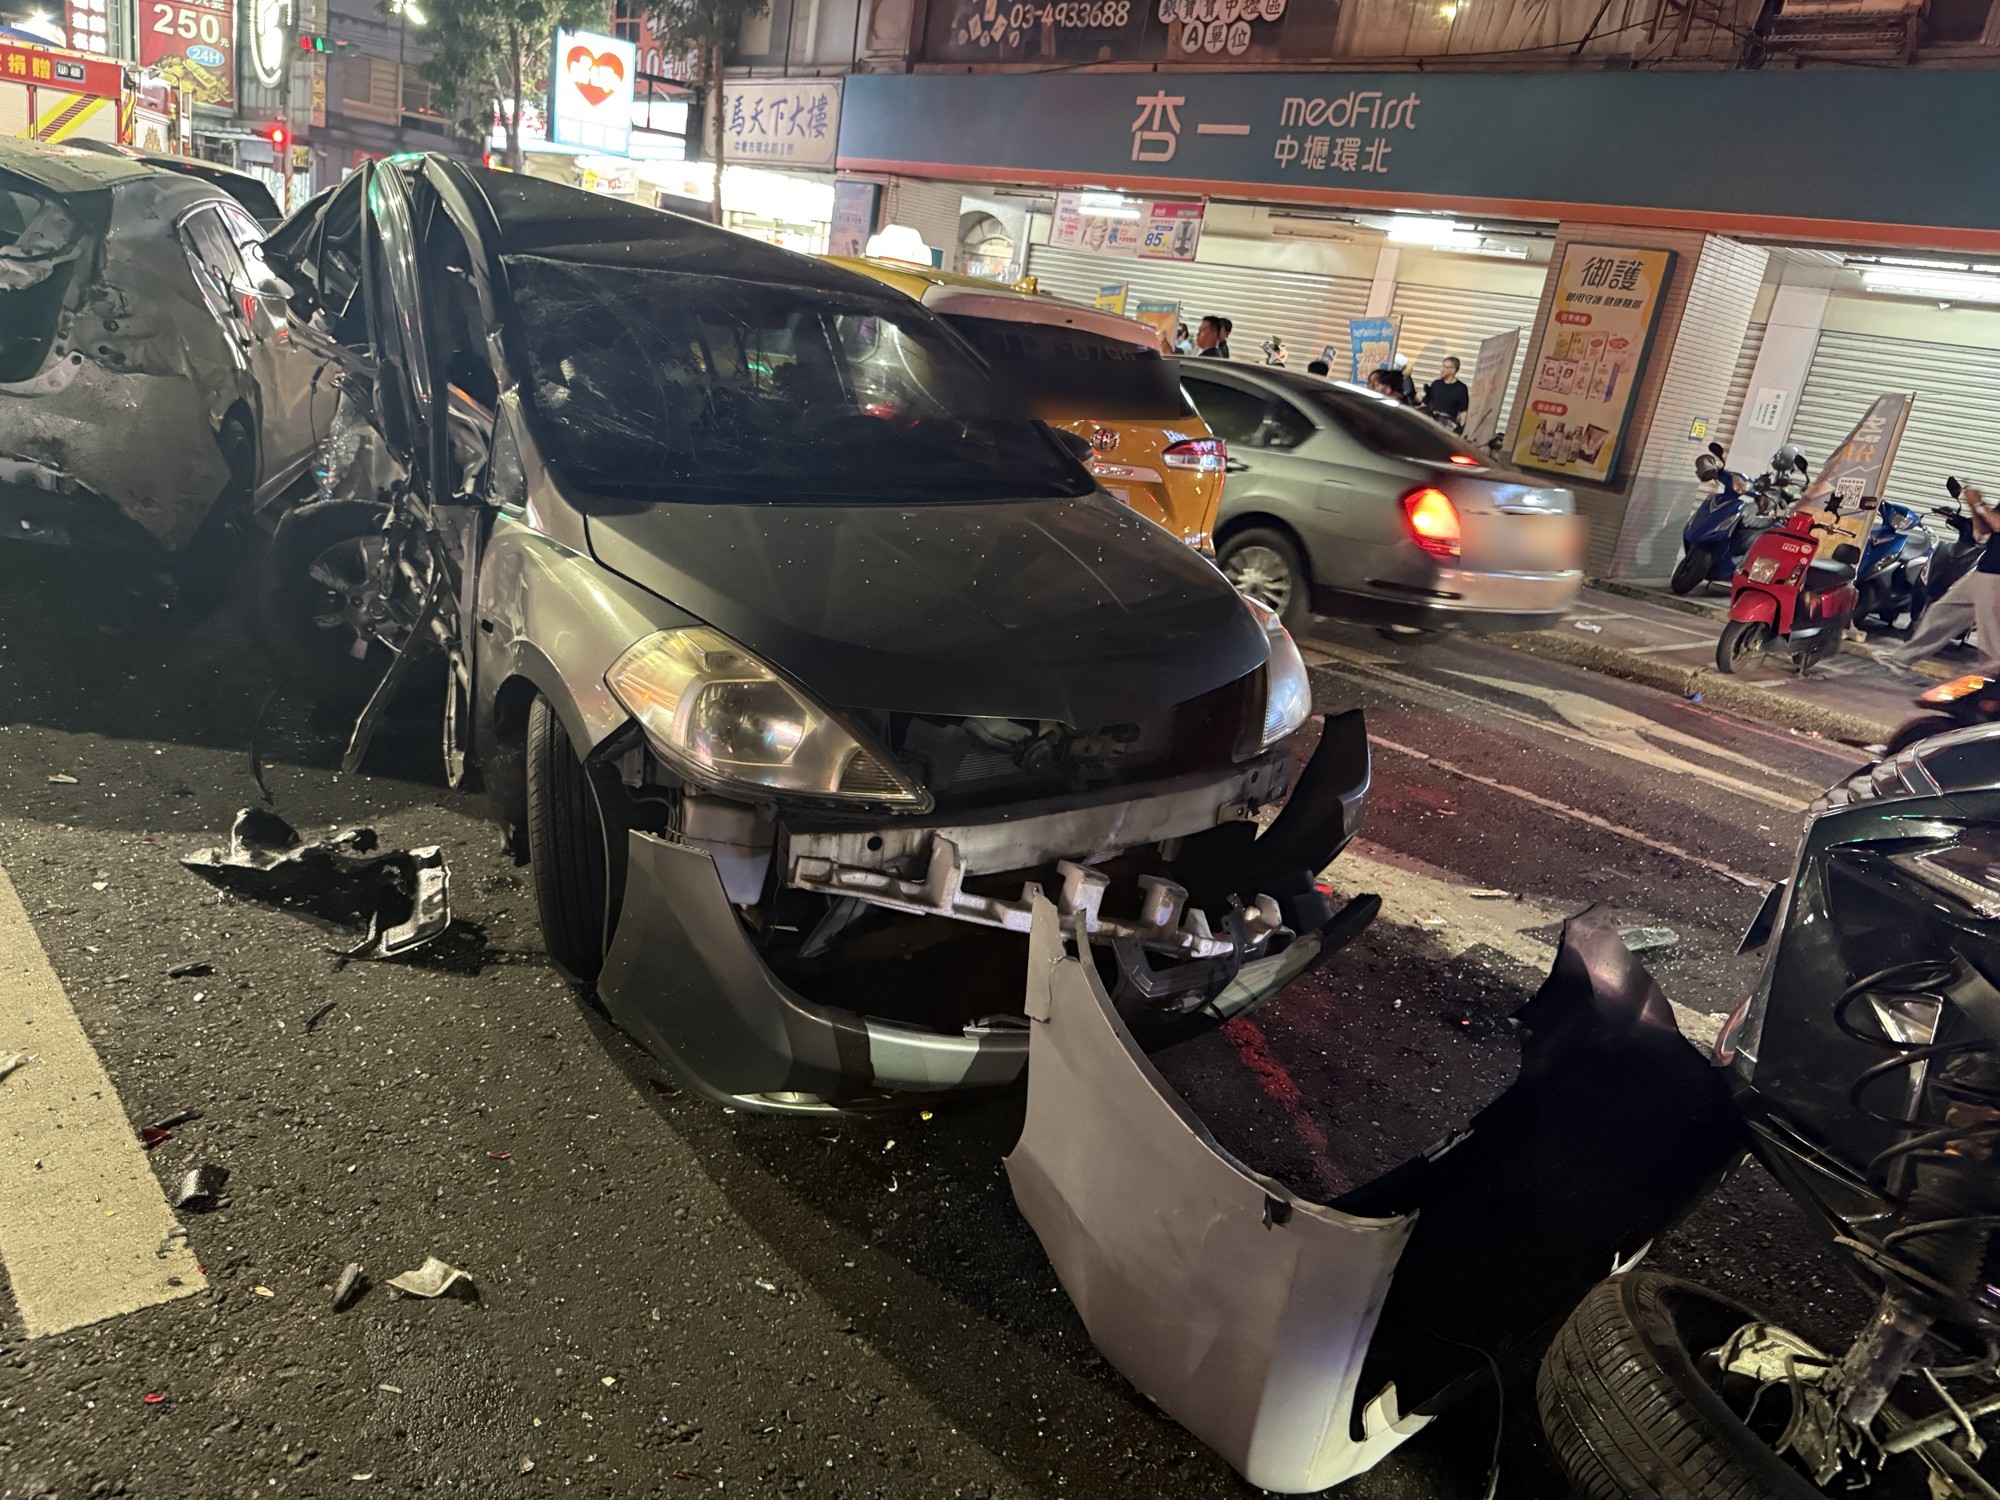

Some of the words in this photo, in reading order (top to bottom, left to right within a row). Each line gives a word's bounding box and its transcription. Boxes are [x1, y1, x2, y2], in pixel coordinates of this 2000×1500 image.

[1010, 0, 1131, 29] 03-4933688
[0, 53, 51, 79] 捐贈
[192, 47, 220, 64] 24H
[713, 93, 829, 139] 馬天下大樓
[1131, 89, 1250, 163] 杏一
[1273, 134, 1393, 173] 中壢環北
[1581, 256, 1644, 291] 御護
